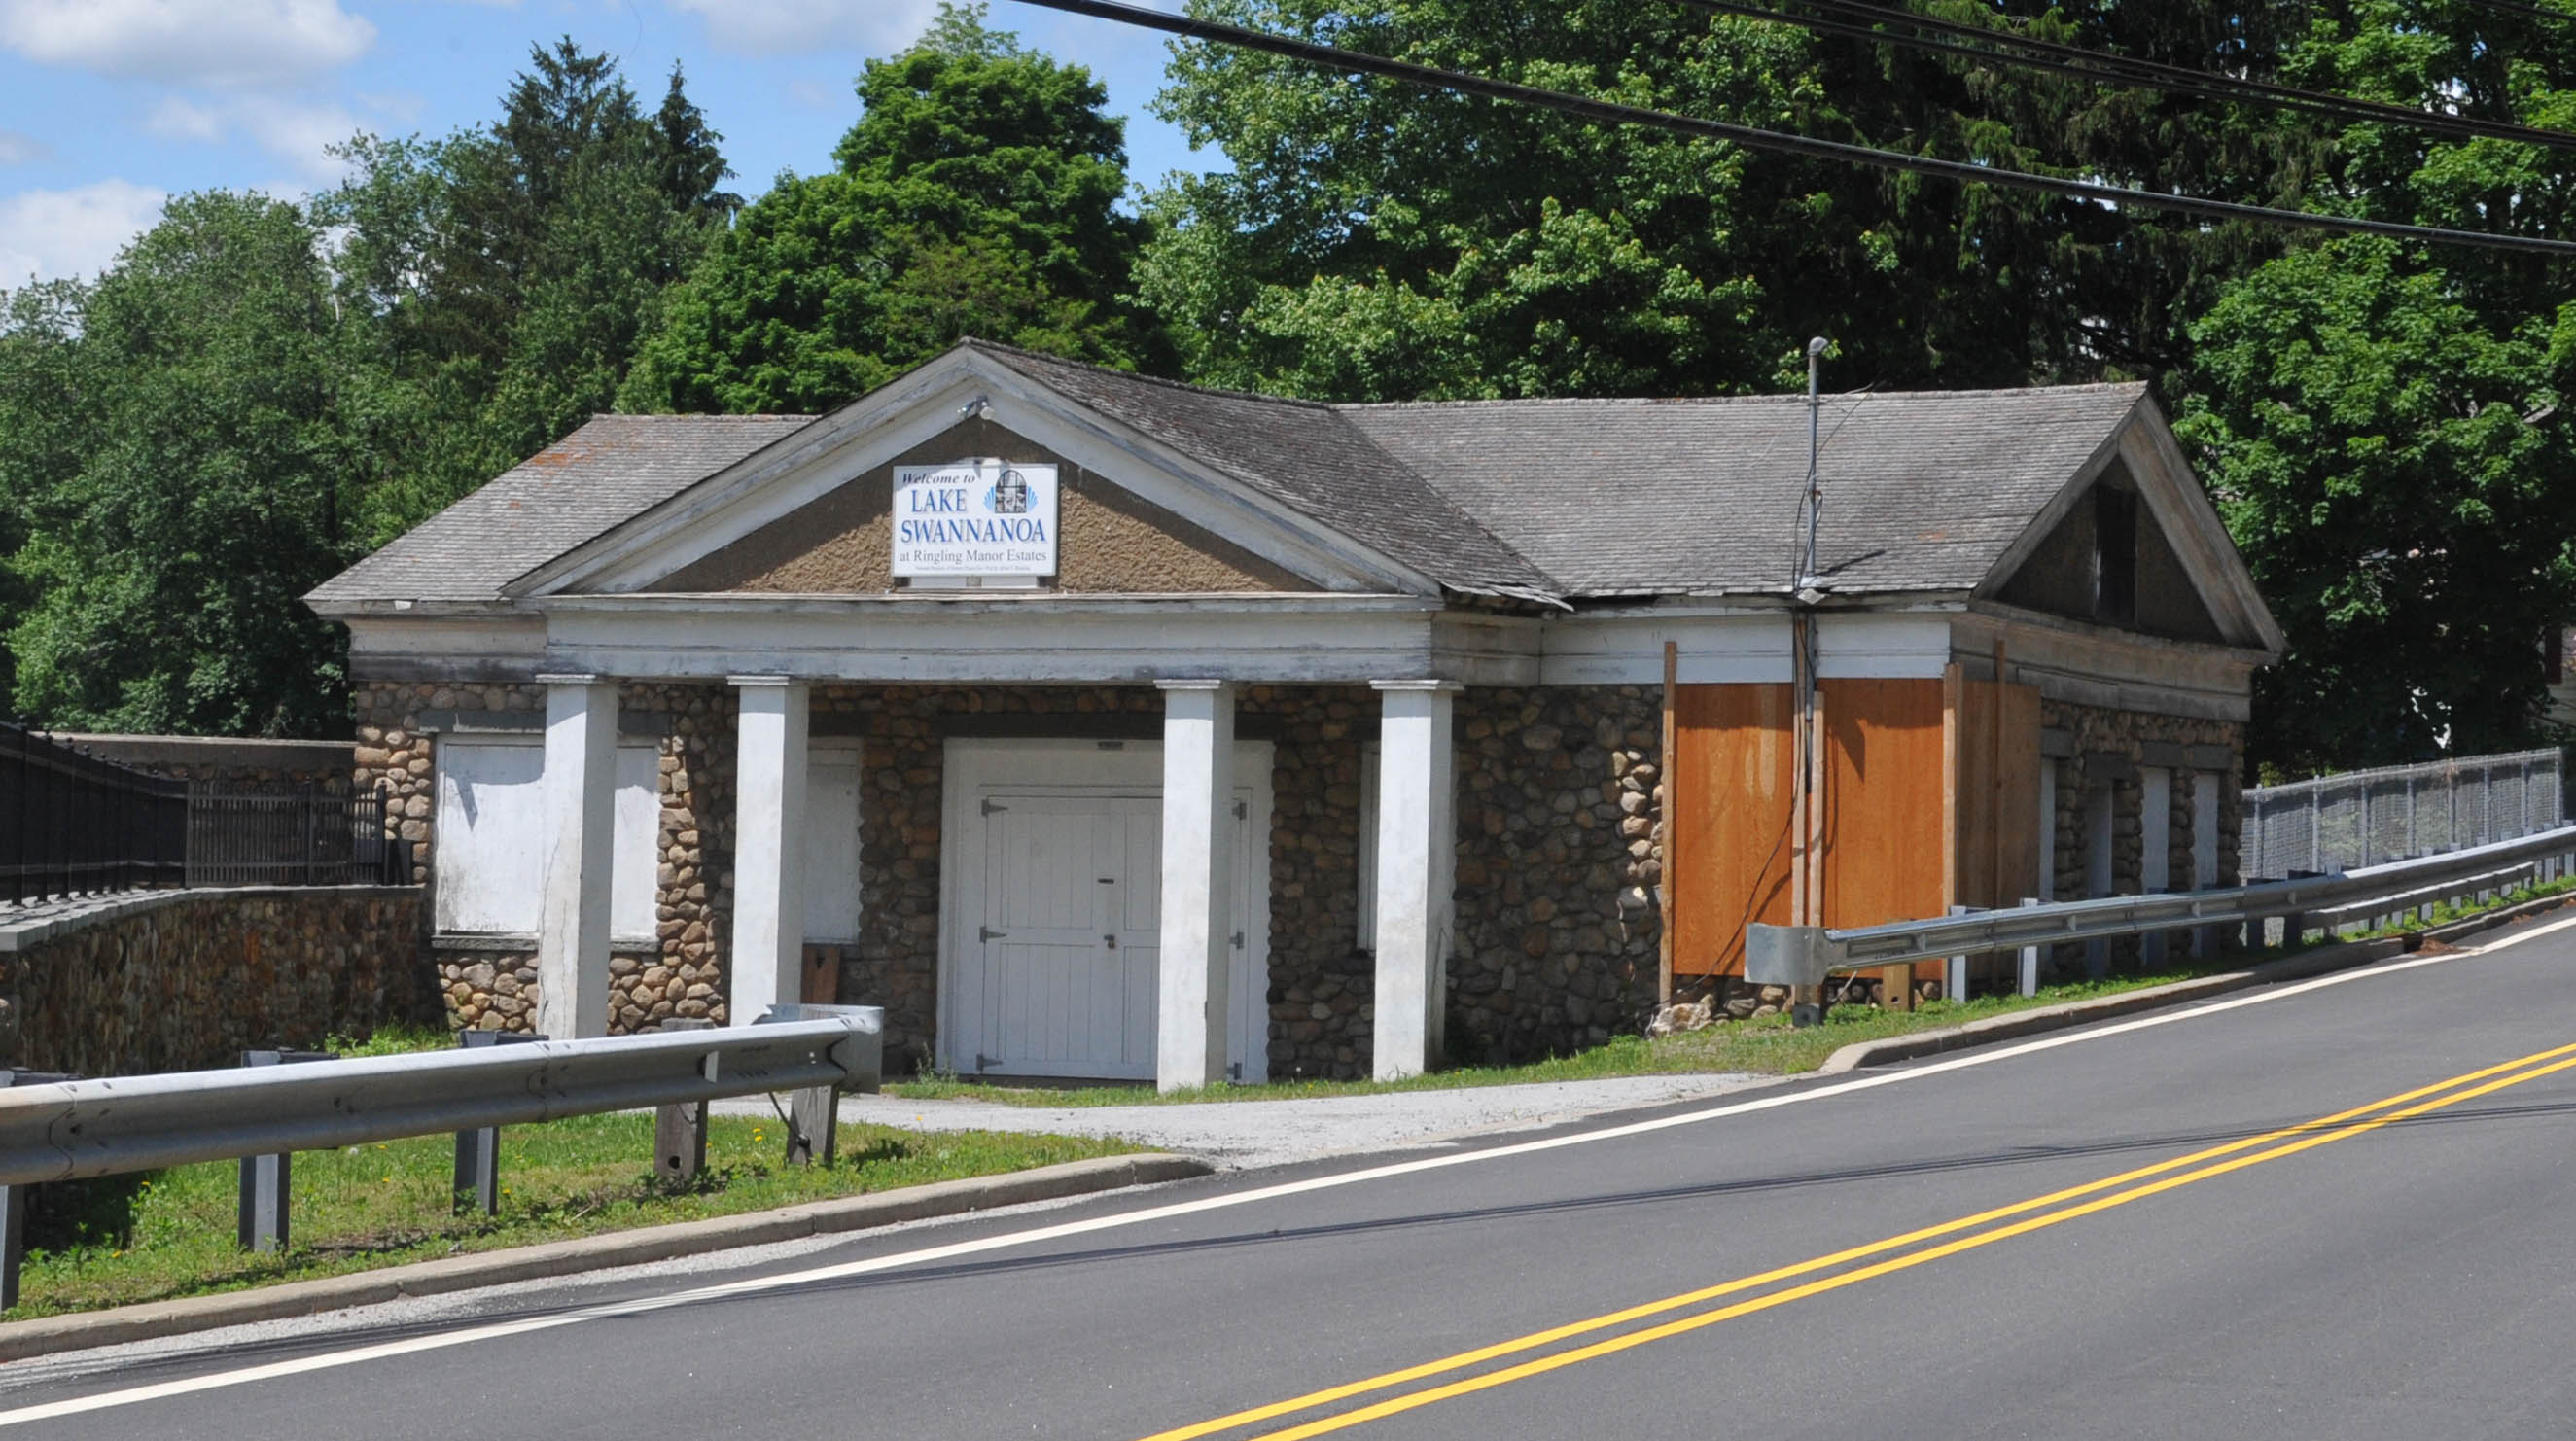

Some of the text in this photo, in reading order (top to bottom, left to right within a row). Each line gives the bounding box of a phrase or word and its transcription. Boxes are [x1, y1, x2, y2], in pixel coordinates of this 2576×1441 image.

[902, 473, 975, 484] Welcome to
[911, 489, 967, 512] LAKE
[900, 518, 1046, 543] SWANNANOA
[900, 549, 1047, 565] at Ringling Manor Estates
